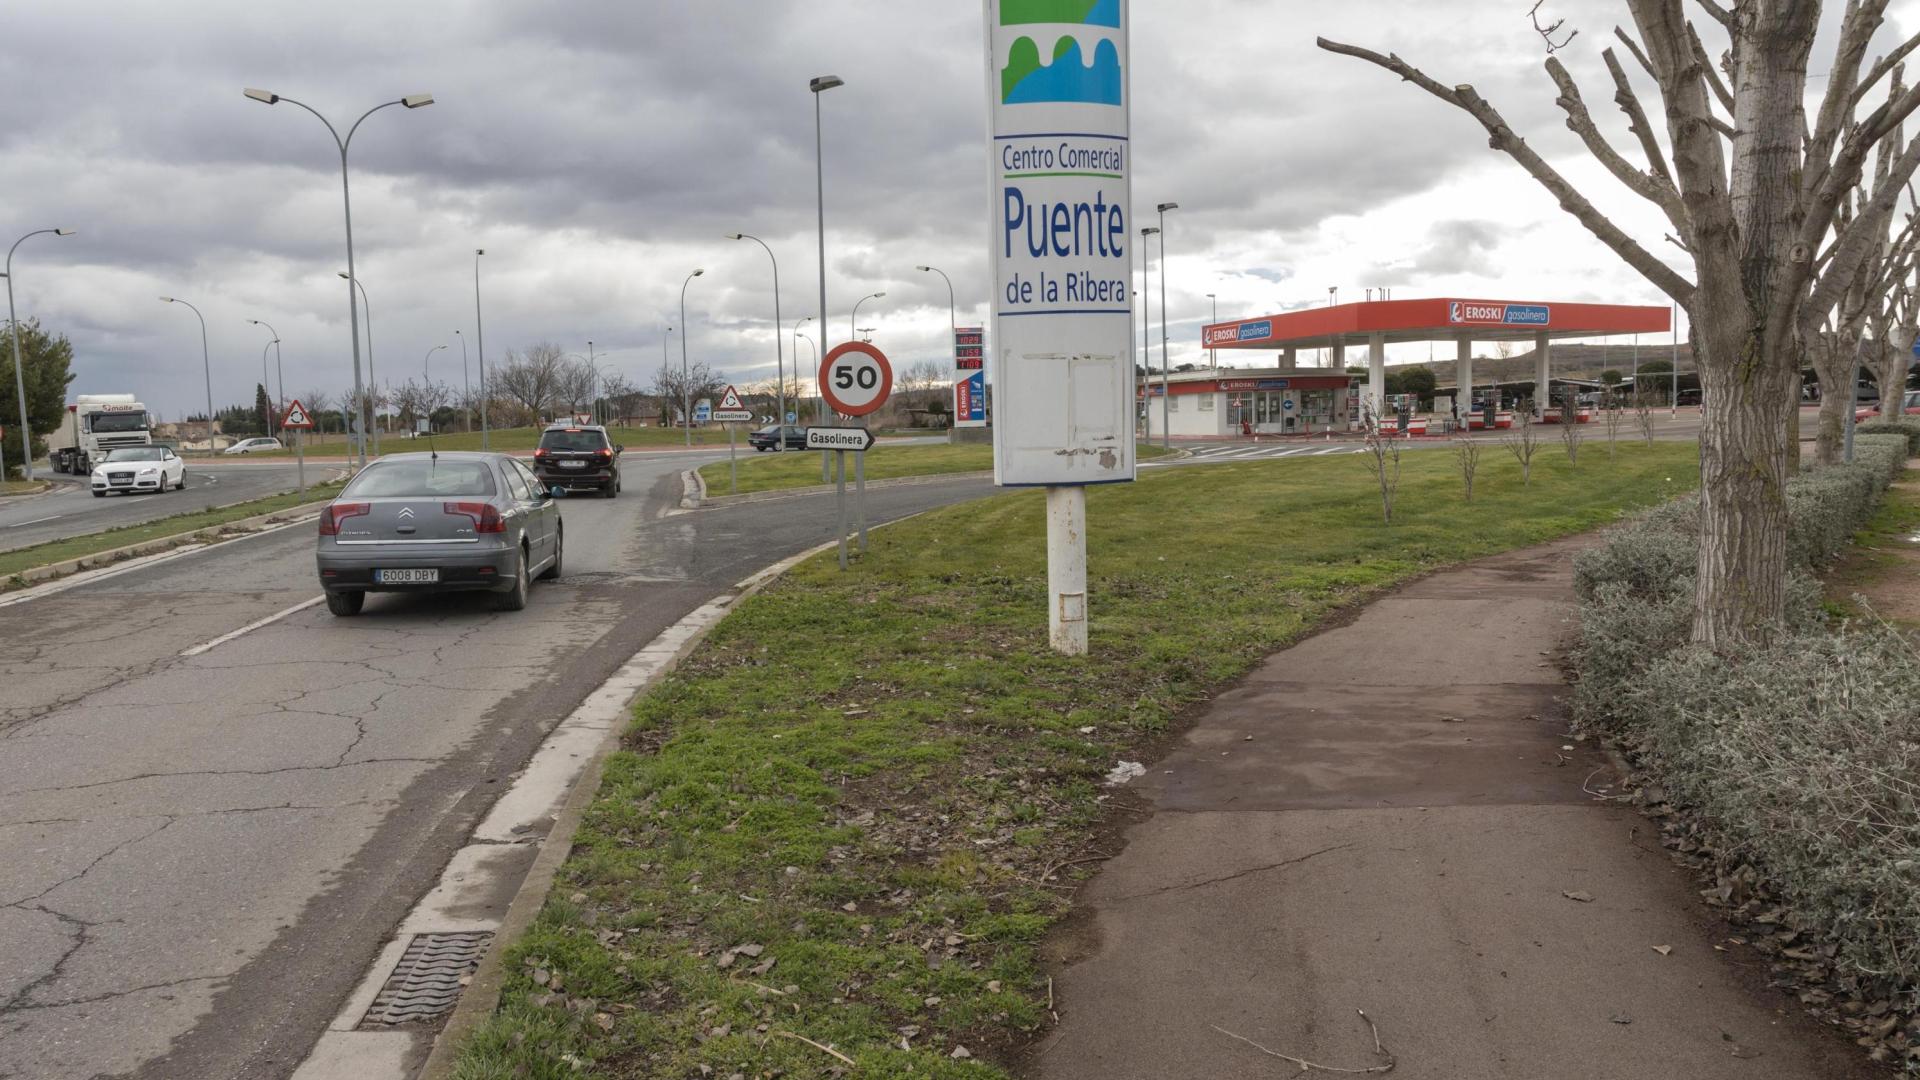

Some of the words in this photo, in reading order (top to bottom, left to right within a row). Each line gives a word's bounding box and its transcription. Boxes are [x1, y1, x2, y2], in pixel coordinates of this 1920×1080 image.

[1002, 144, 1054, 171] Centro
[1058, 142, 1123, 171] Comercial
[1003, 186, 1124, 258] Puente
[1006, 272, 1033, 304] de
[1040, 271, 1058, 303] la
[1066, 270, 1125, 303] Ribera
[1465, 306, 1502, 320] EROSKI
[1507, 307, 1546, 323] gasolinera
[1213, 328, 1237, 341] EROSKI
[835, 365, 877, 390] 50
[810, 432, 863, 445] Gasolinera
[383, 570, 412, 581] 6008
[414, 570, 437, 581] DBY
